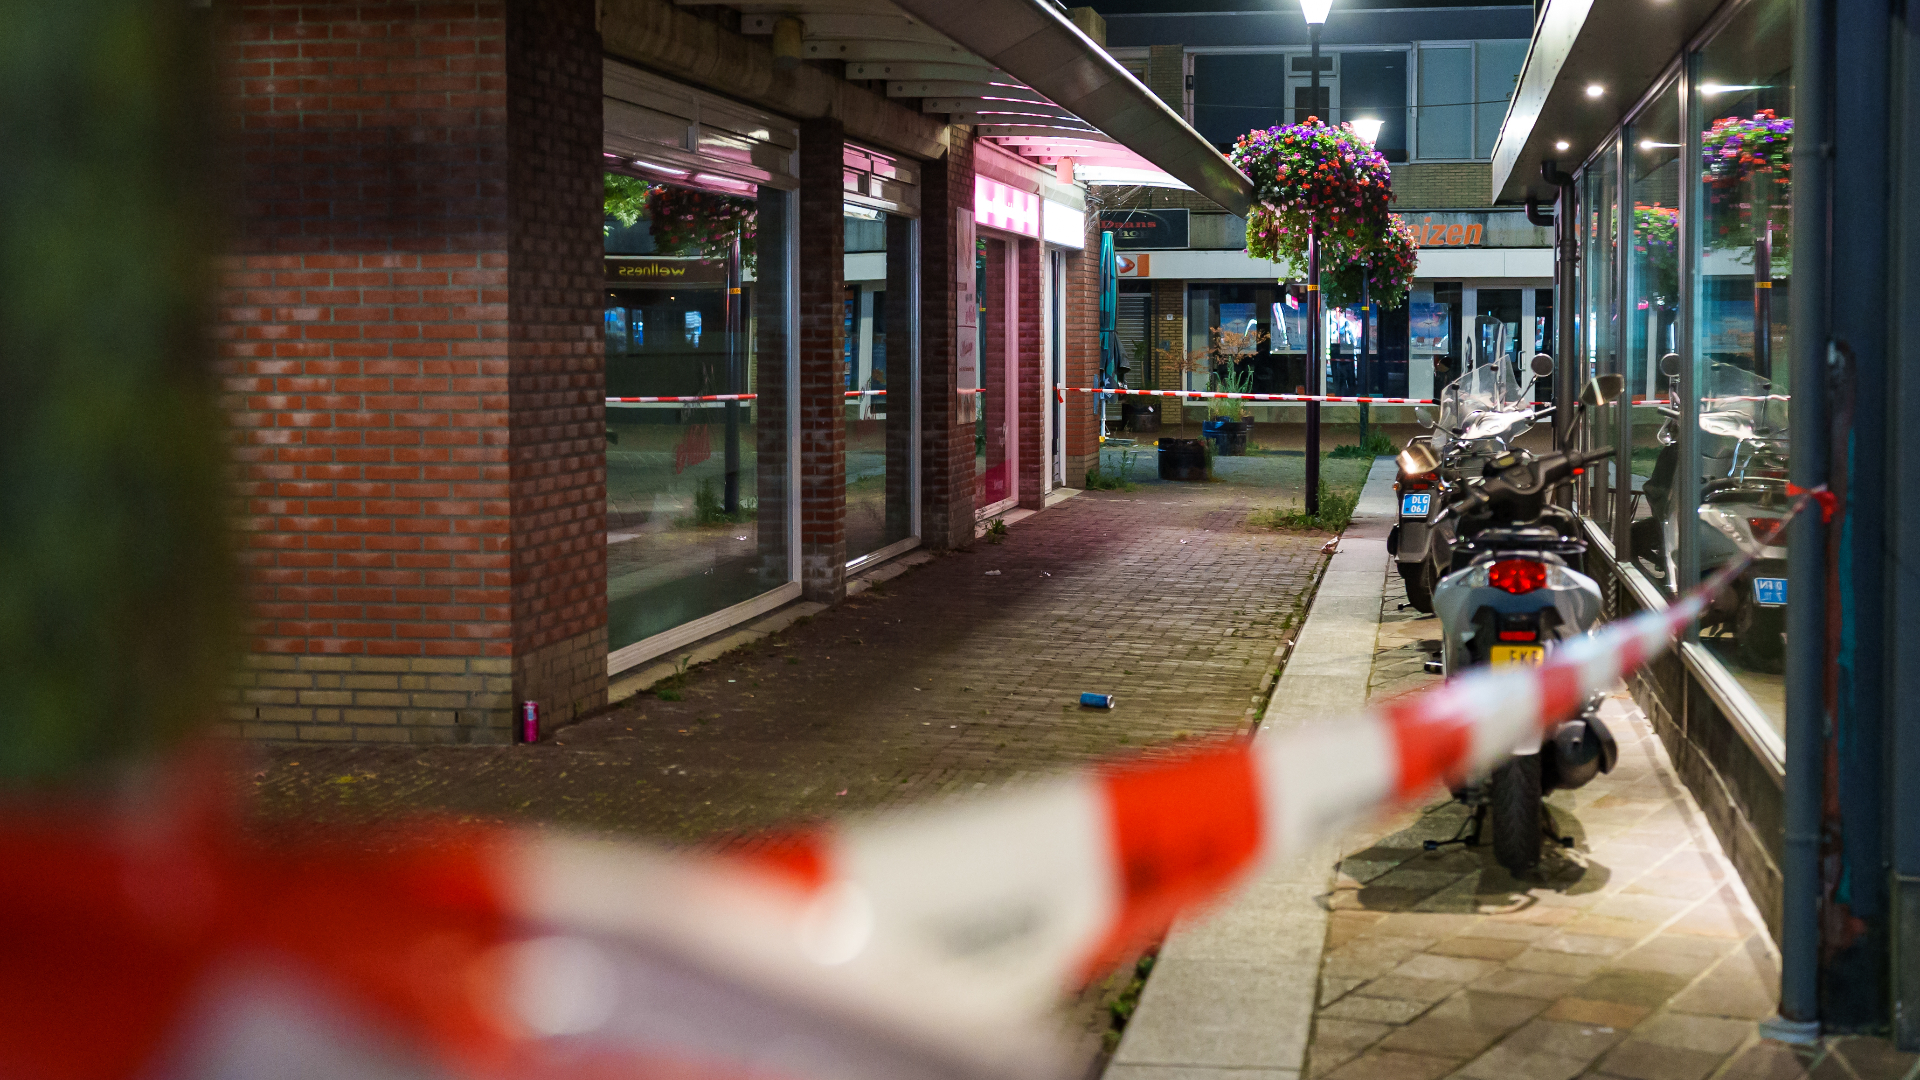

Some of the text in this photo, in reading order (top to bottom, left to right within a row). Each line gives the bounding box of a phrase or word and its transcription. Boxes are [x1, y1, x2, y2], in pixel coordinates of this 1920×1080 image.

[1407, 216, 1483, 245] eizen
[1411, 495, 1429, 504] DLG
[1410, 504, 1427, 513] 06J
